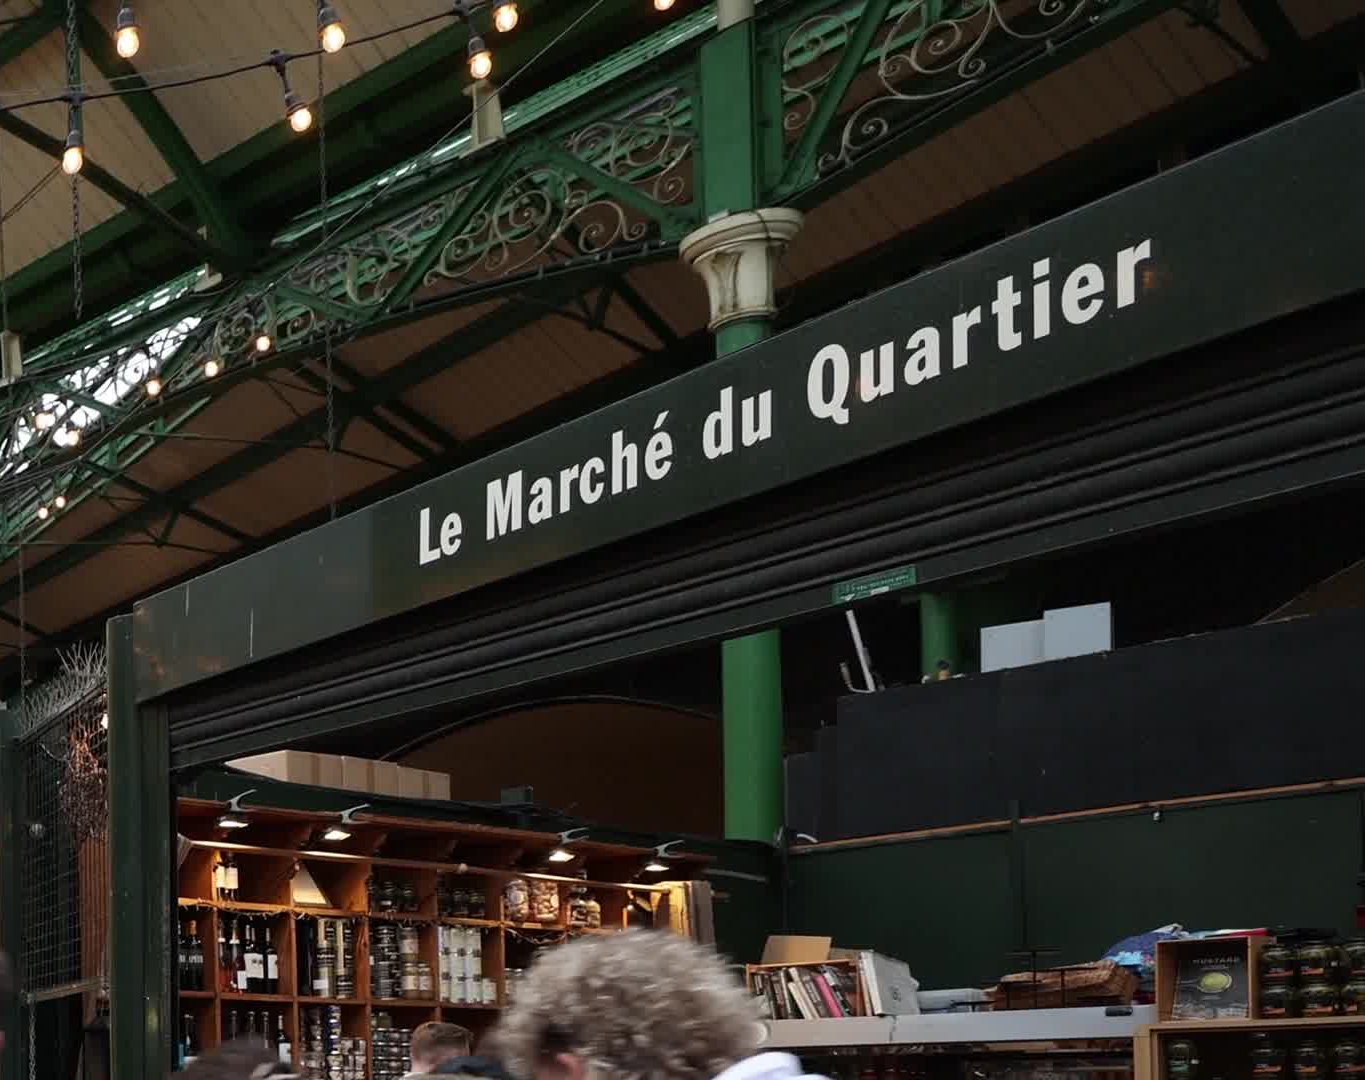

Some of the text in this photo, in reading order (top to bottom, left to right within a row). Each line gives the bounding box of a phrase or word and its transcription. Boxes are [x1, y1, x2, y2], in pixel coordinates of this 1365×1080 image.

[418, 239, 1152, 566] Le Marché du Quartier
